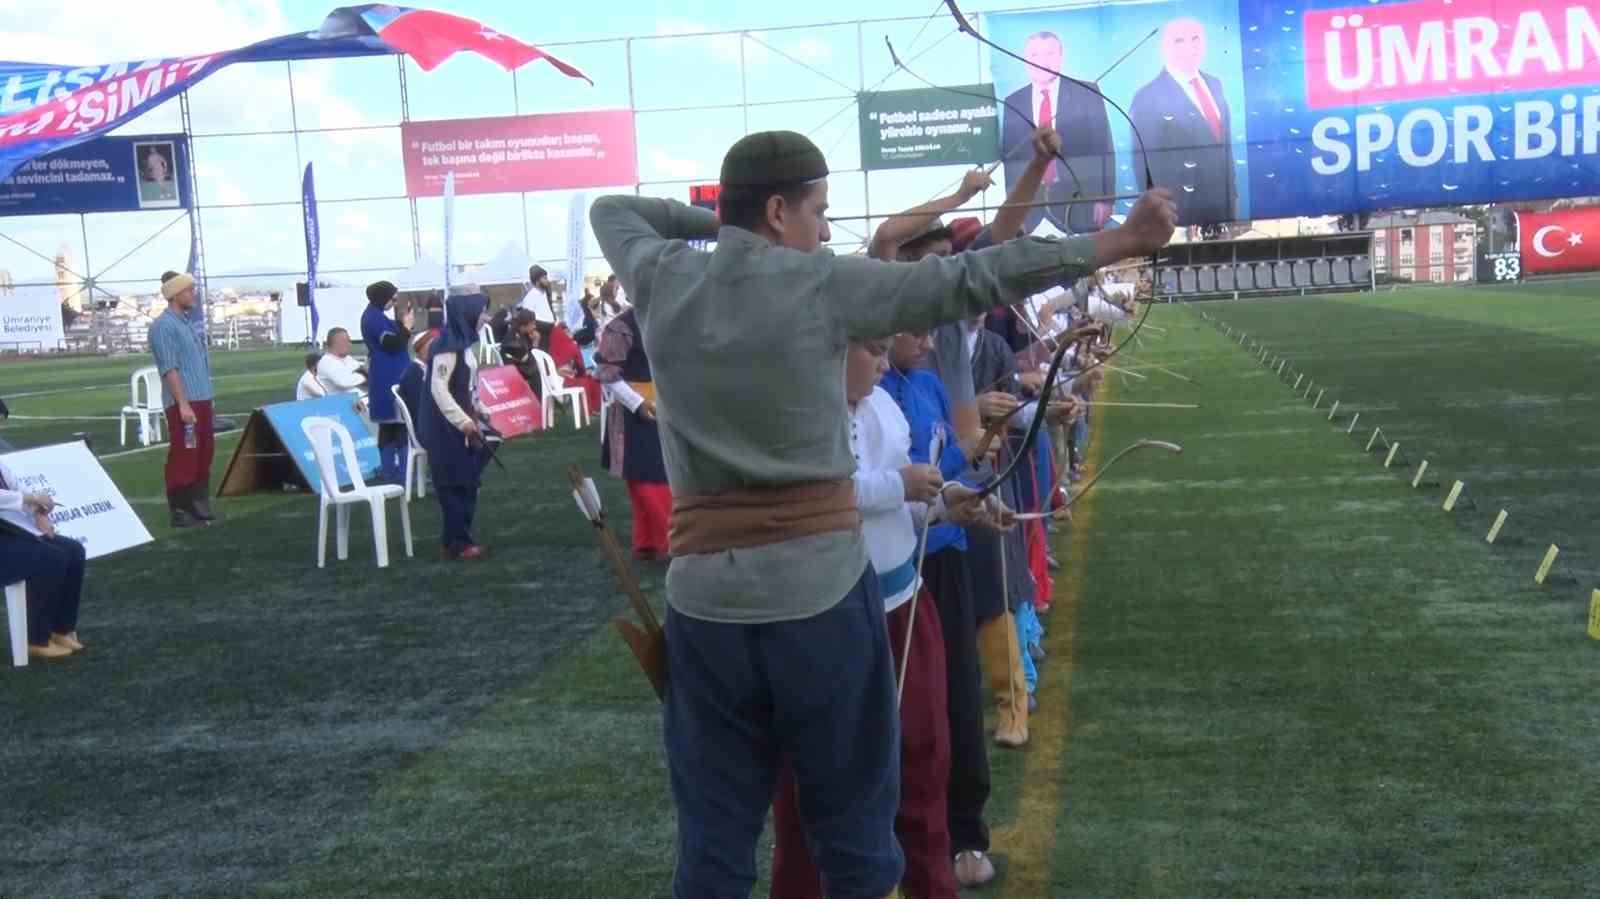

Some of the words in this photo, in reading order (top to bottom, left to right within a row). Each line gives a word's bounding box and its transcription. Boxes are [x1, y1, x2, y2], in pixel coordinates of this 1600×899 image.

[880, 110, 917, 124] Futbol
[422, 140, 456, 153] Futbol
[458, 139, 473, 151] bir
[475, 138, 506, 150] takım
[1310, 105, 1496, 176] SPOR
[32, 160, 47, 170] ter
[49, 159, 109, 170] dökmeyen,
[423, 154, 440, 166] tek
[478, 151, 505, 165] değil
[16, 173, 64, 184] sevincini
[1495, 258, 1520, 276] 83
